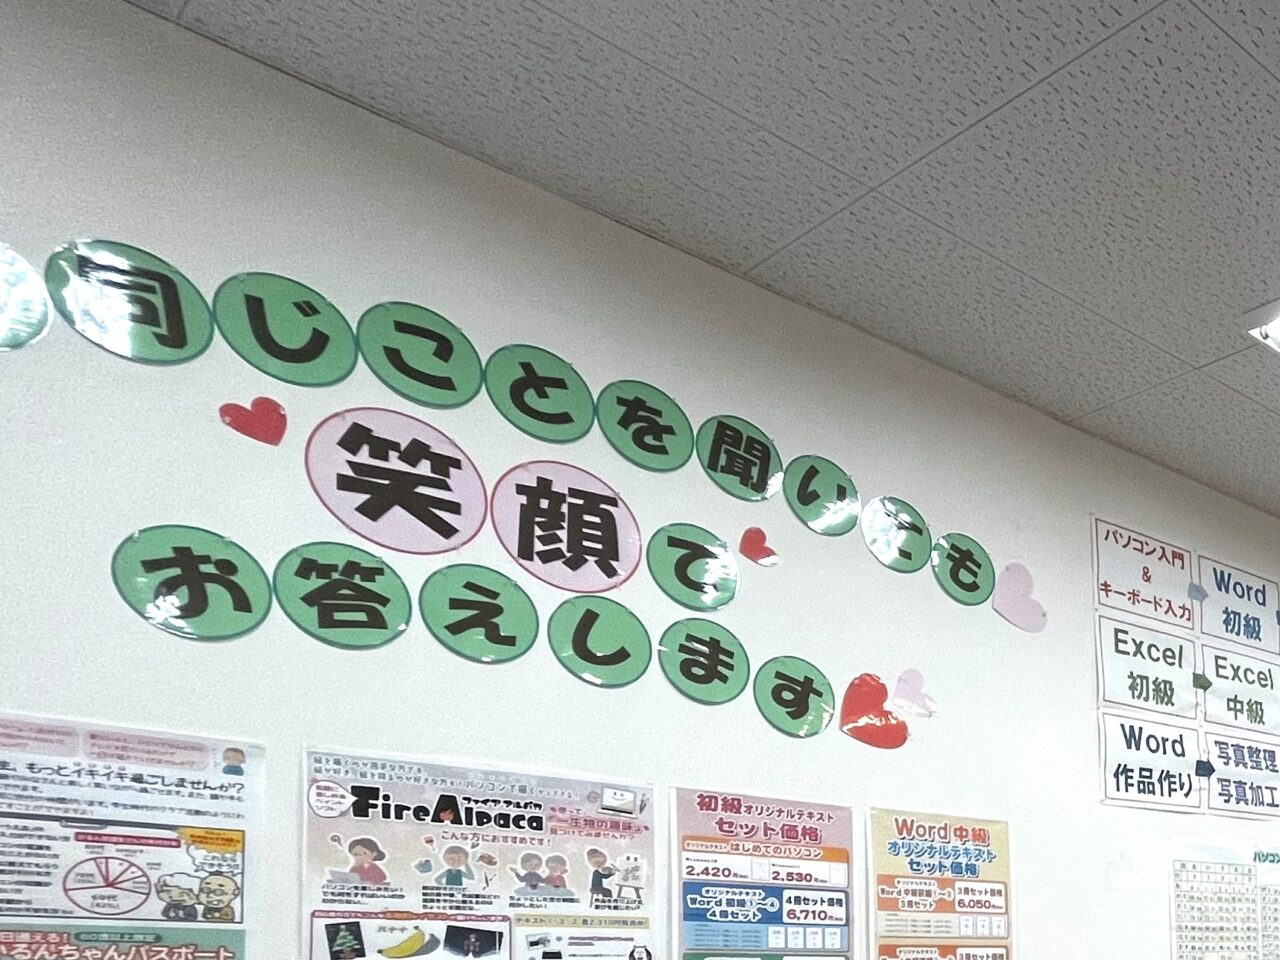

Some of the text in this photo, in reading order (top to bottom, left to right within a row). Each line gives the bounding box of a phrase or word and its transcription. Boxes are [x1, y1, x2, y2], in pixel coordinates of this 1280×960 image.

[1104, 529, 1185, 571] パソコン入門
[1141, 566, 1152, 584] &
[1212, 566, 1267, 607] Word
[1099, 580, 1192, 622] キーボード入力
[141, 545, 823, 722] お答えします
[1222, 606, 1263, 643] 初級
[1113, 627, 1184, 669] Excel
[1127, 670, 1176, 707] 初級
[1214, 654, 1275, 691] Excel
[1226, 694, 1266, 726] 中級
[1120, 723, 1186, 758] Word
[1214, 740, 1280, 774] 写真整理
[1113, 763, 1194, 798] 作品作り
[1217, 777, 1280, 808] 写真加工
[351, 785, 544, 832] FireAlpaca
[696, 793, 835, 824] 初級オリジナルテキスト
[715, 817, 822, 845] セット価格
[894, 817, 990, 845] Word 中級
[730, 841, 823, 859] はじめてのパソコン
[887, 840, 997, 863] オリジナルテキスト
[907, 857, 980, 879] セット価格
[688, 897, 723, 908] Word
